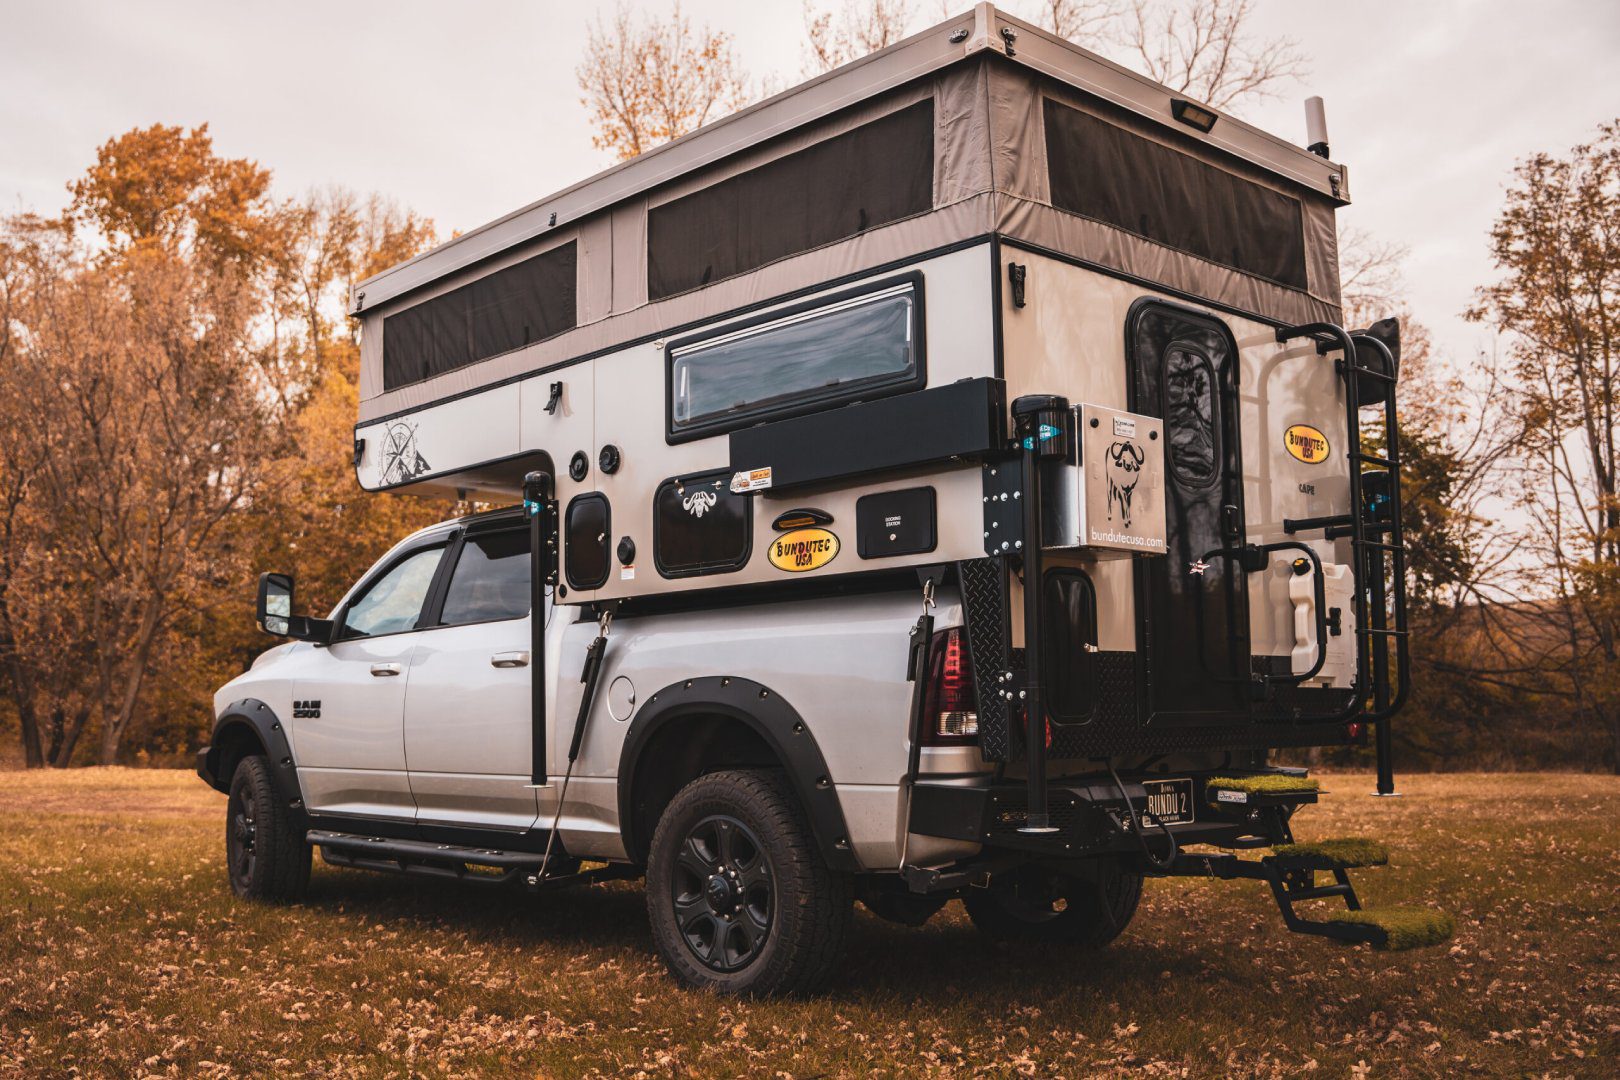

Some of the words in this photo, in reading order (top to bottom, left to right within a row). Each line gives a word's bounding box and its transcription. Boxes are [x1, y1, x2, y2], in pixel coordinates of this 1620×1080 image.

[1289, 431, 1325, 451] BUNDUTEC
[1302, 447, 1314, 459] USA
[1299, 483, 1315, 496] CAPE
[1091, 526, 1163, 547] bundutecusa.com
[776, 538, 831, 557] BUNDUTEC
[795, 553, 813, 566] USA
[293, 700, 321, 709] RAM
[293, 709, 321, 718] 2500
[1180, 792, 1187, 813] 2
